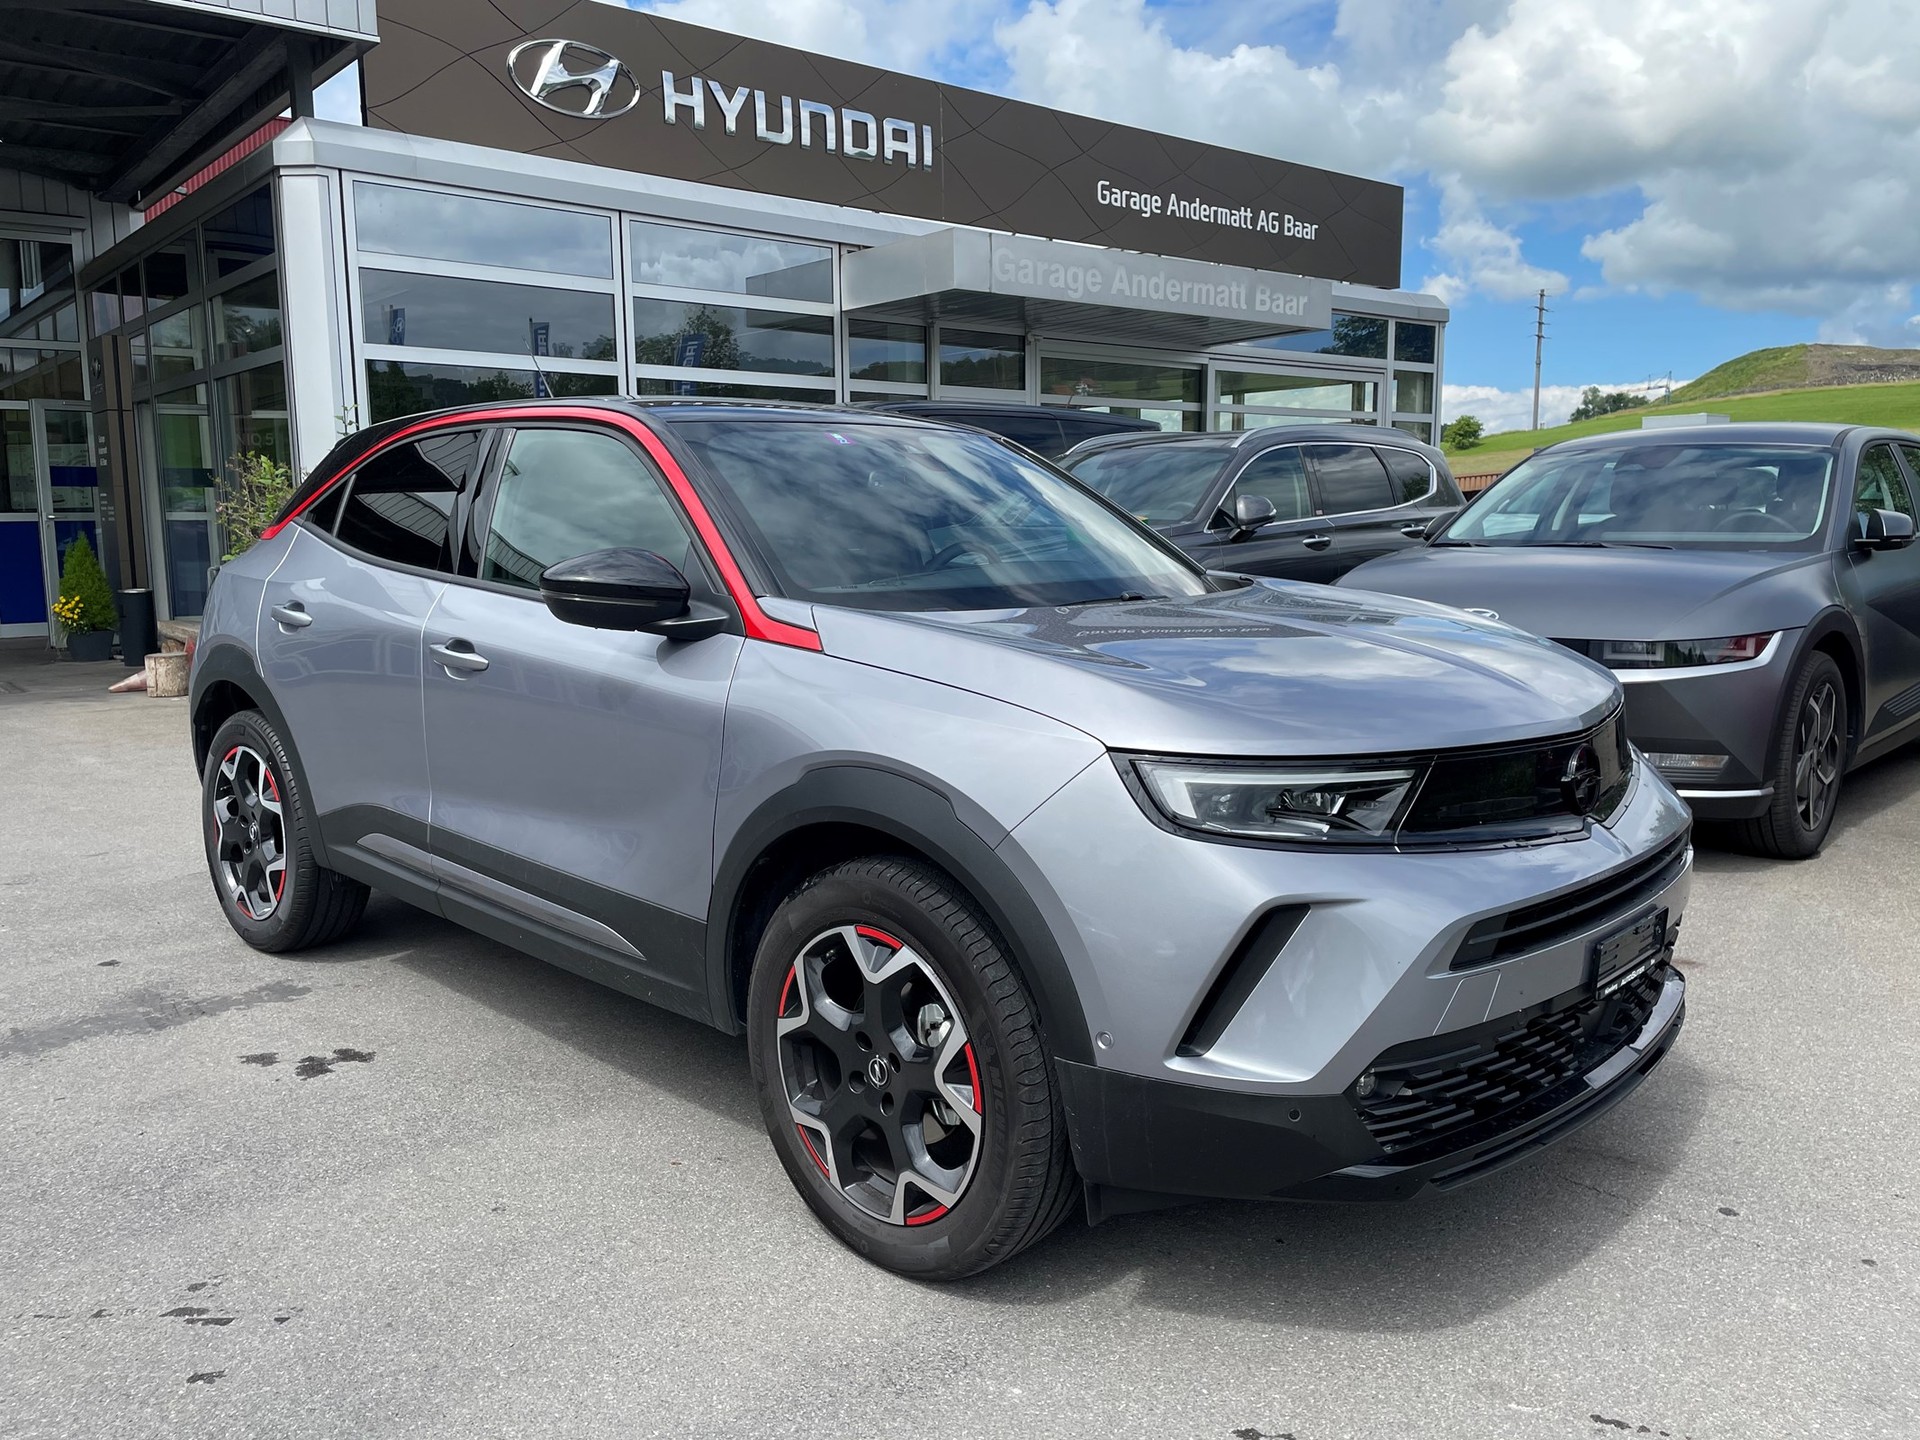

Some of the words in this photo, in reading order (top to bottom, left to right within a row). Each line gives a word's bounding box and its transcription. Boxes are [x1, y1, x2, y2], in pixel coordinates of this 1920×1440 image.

[661, 70, 933, 172] HYUNDAI
[1097, 180, 1162, 218] Garage
[1167, 193, 1253, 230] Andermatt
[1257, 210, 1279, 234] AG
[1284, 215, 1319, 241] Baar
[993, 247, 1103, 298] Garage
[1111, 265, 1248, 310] Andermatt
[1255, 282, 1308, 317] Baar
